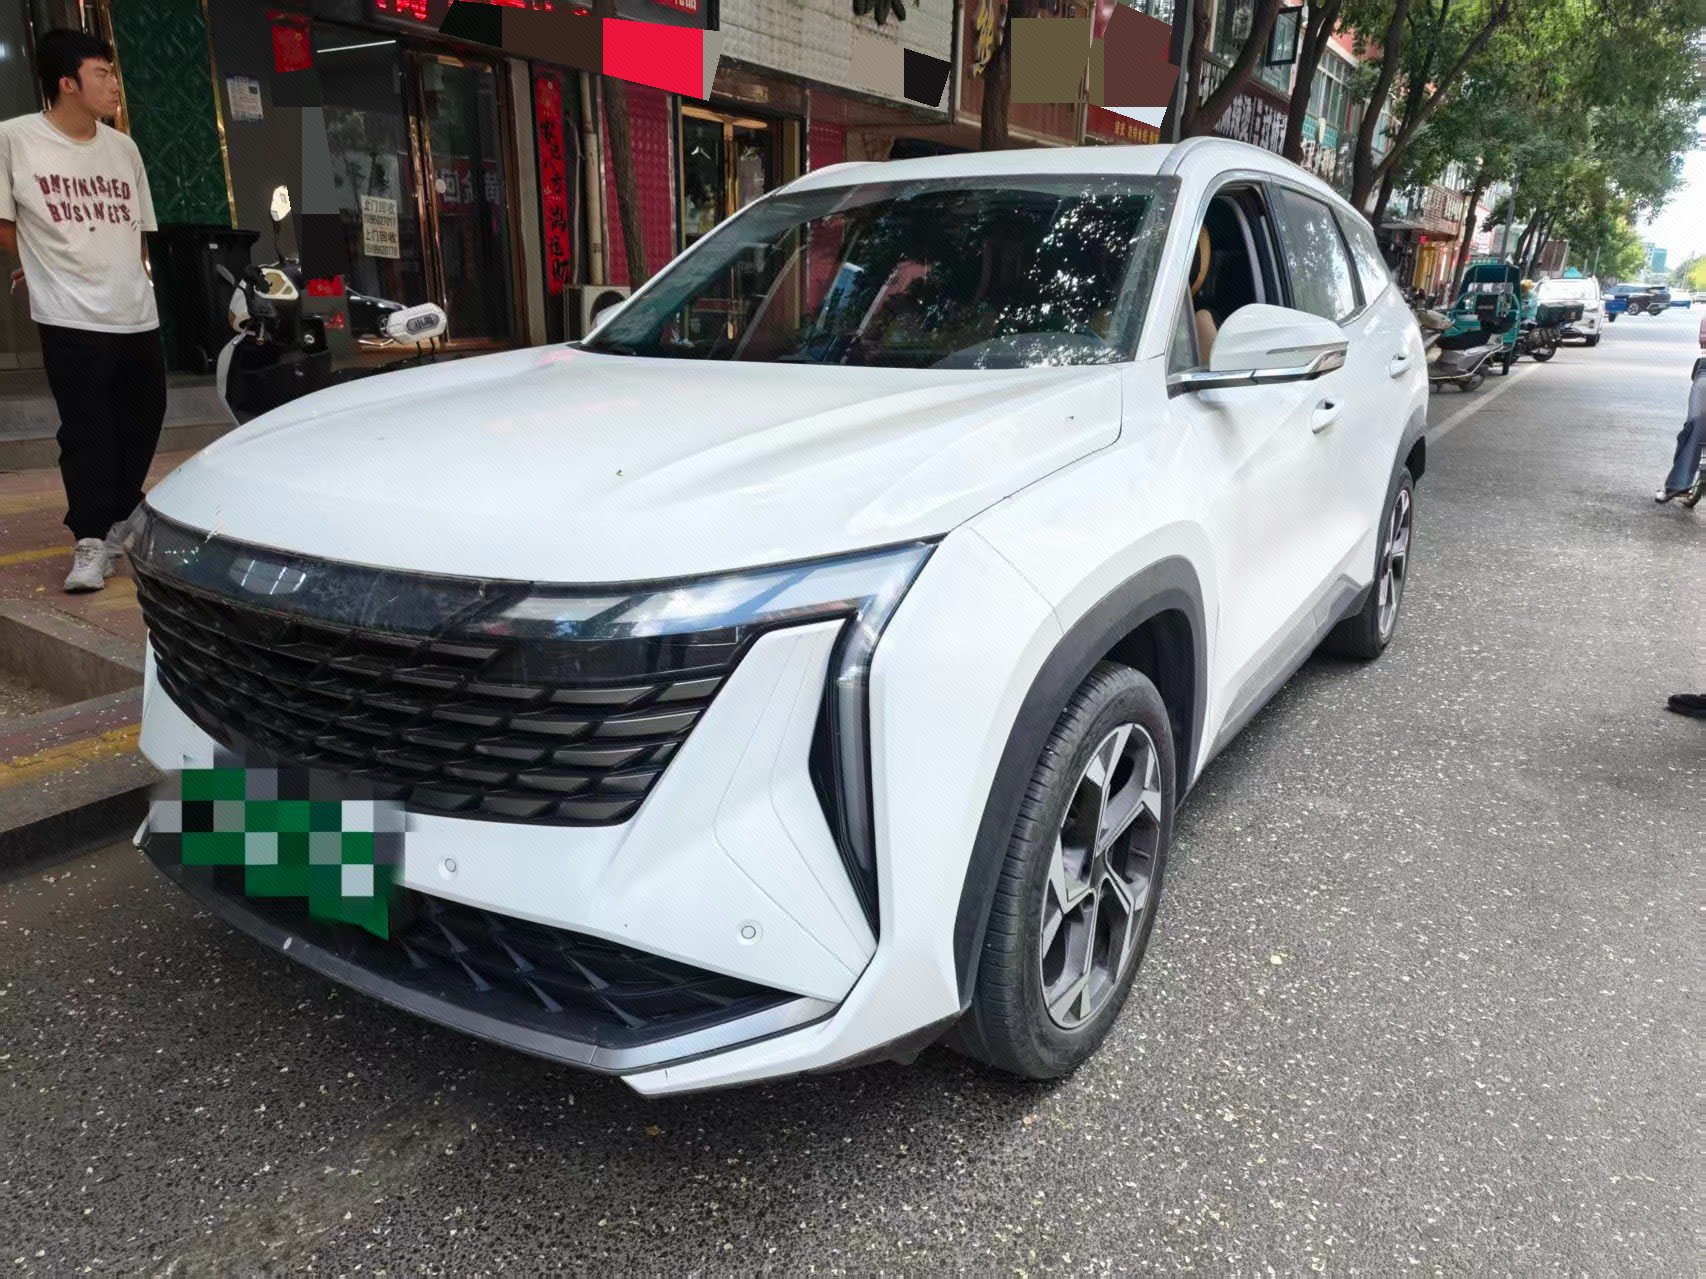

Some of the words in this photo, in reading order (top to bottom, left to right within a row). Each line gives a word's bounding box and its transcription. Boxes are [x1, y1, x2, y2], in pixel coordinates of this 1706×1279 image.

[363, 199, 396, 214] 上门回收
[365, 227, 398, 244] 上门回收
